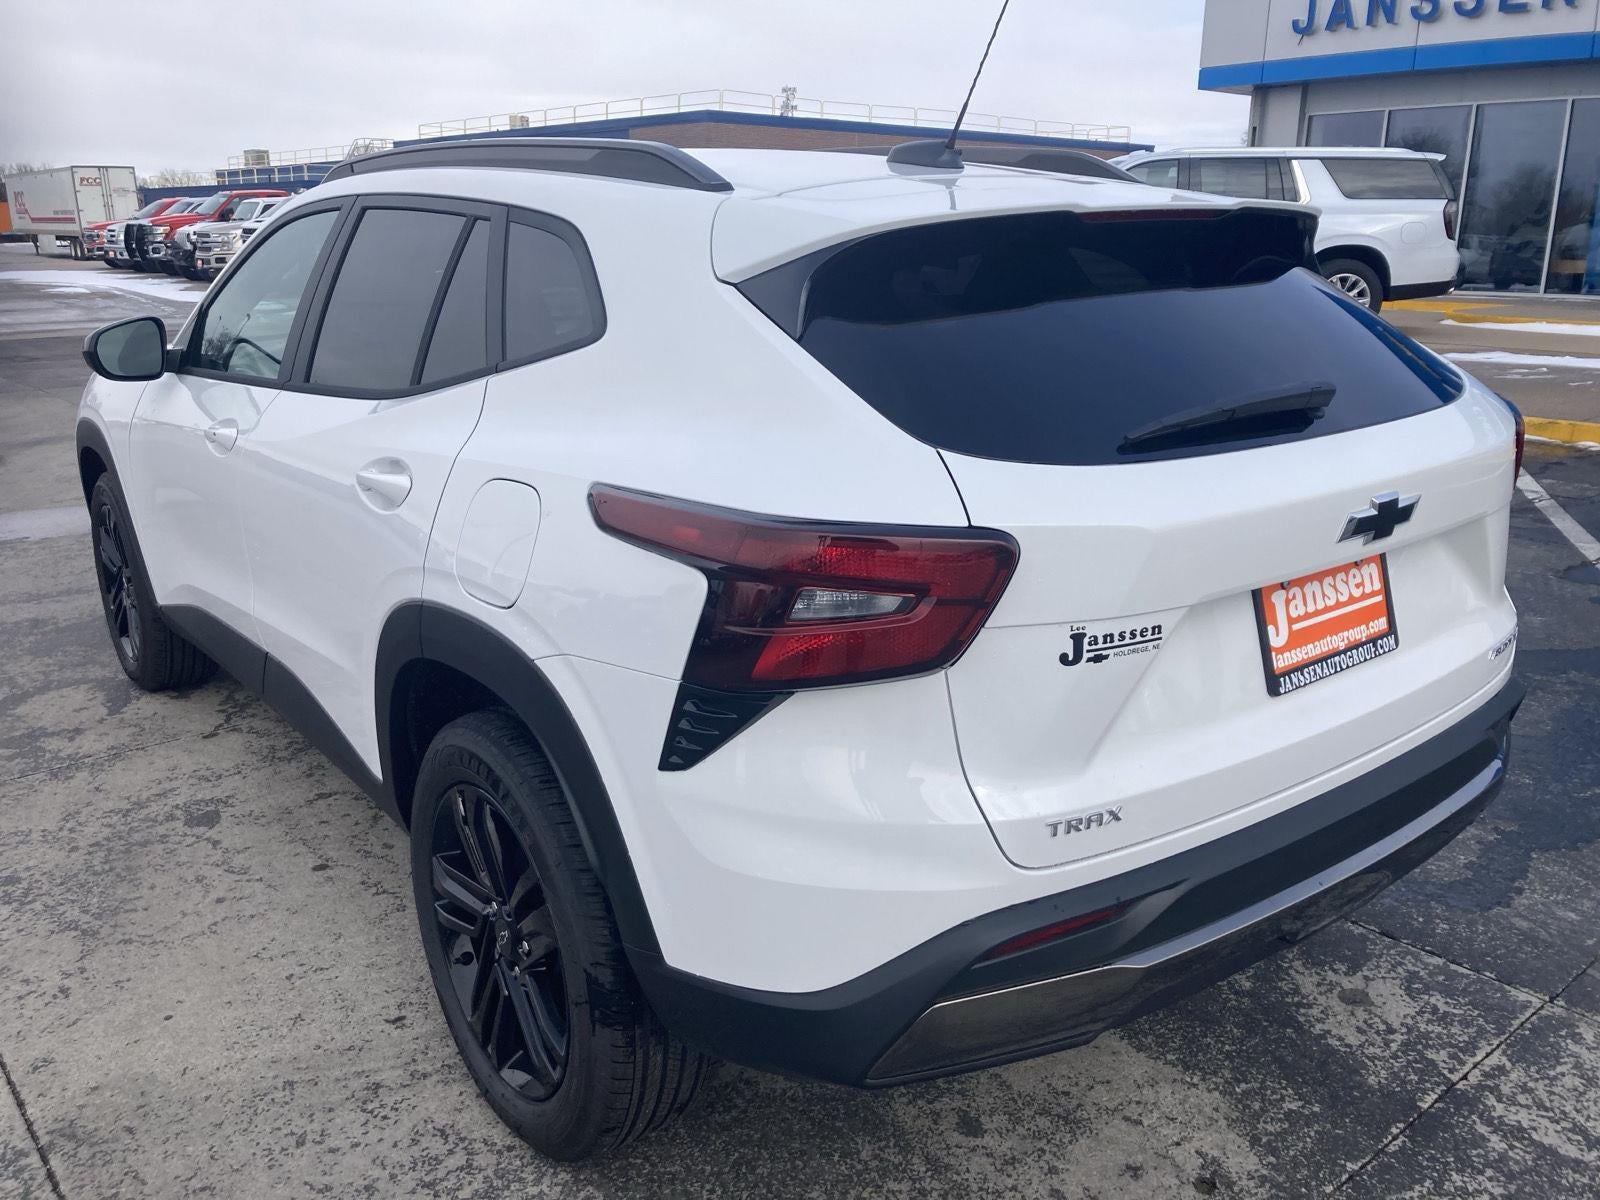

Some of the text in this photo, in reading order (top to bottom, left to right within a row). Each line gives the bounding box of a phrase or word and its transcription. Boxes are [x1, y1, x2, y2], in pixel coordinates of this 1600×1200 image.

[1292, 0, 1577, 34] JANS
[1268, 562, 1382, 648] Janssen
[1059, 624, 1163, 667] Janssen
[1046, 805, 1123, 837] TRAX
